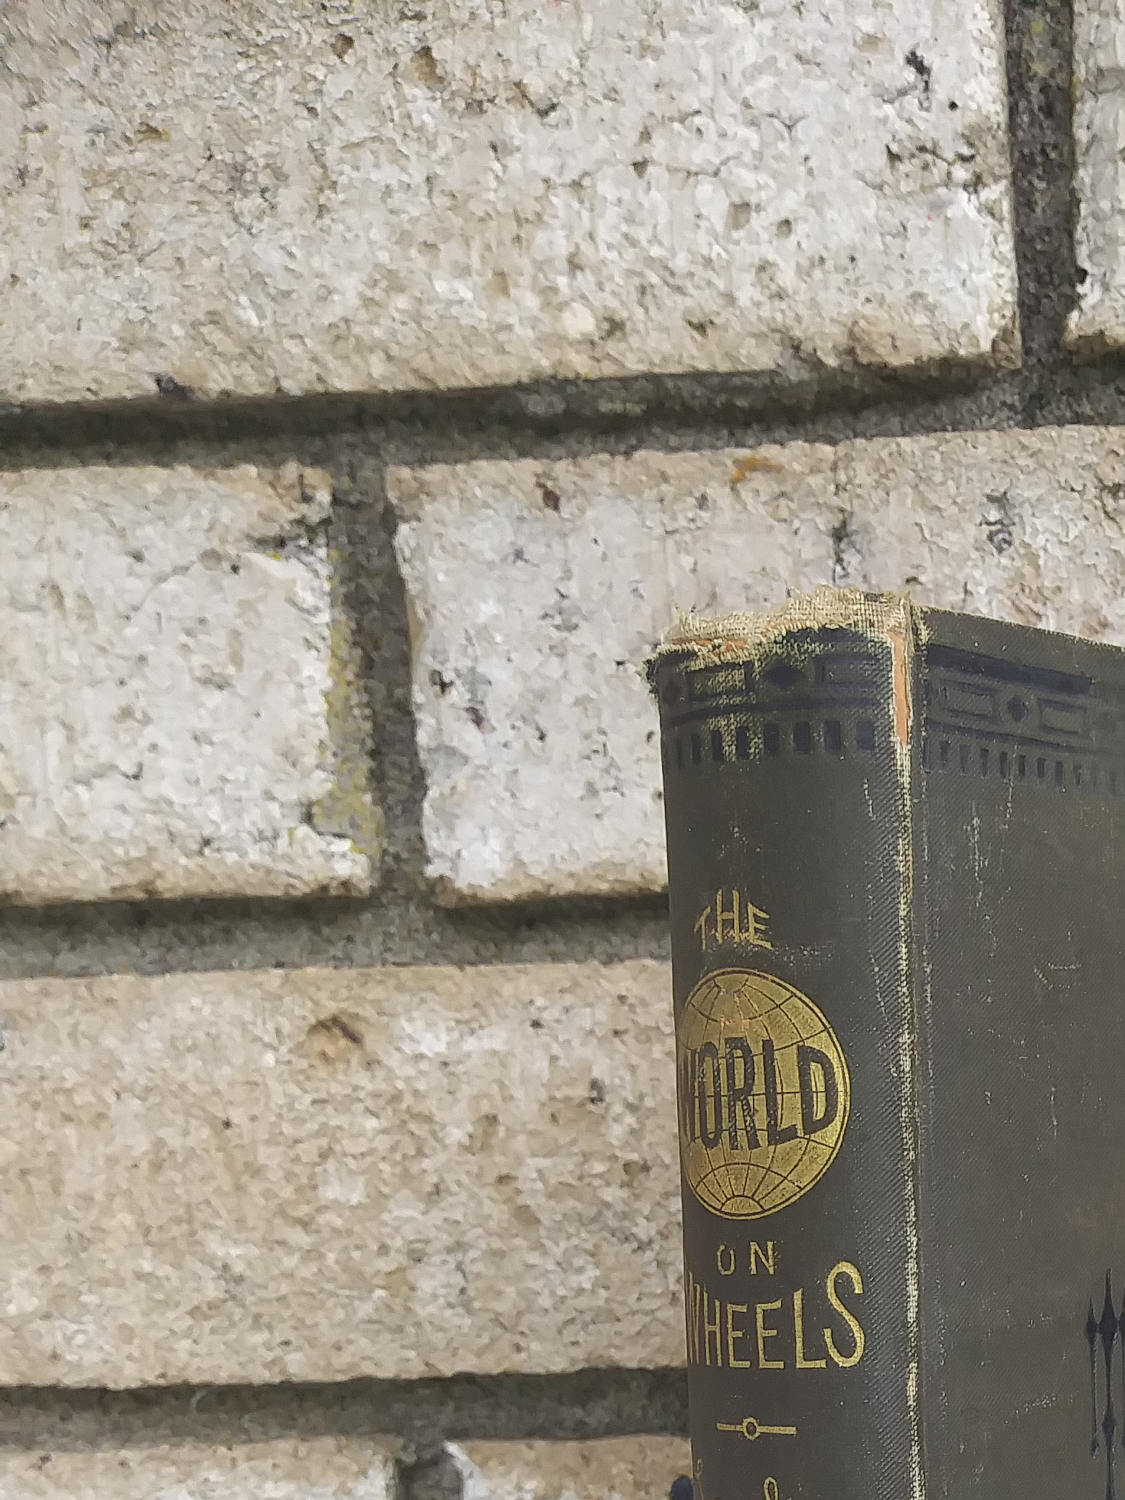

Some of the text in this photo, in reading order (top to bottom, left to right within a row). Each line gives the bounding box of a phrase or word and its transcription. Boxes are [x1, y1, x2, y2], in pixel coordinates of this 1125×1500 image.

[694, 888, 775, 952] THE
[717, 1241, 775, 1276] ON
[687, 1261, 865, 1369] WHEELS
